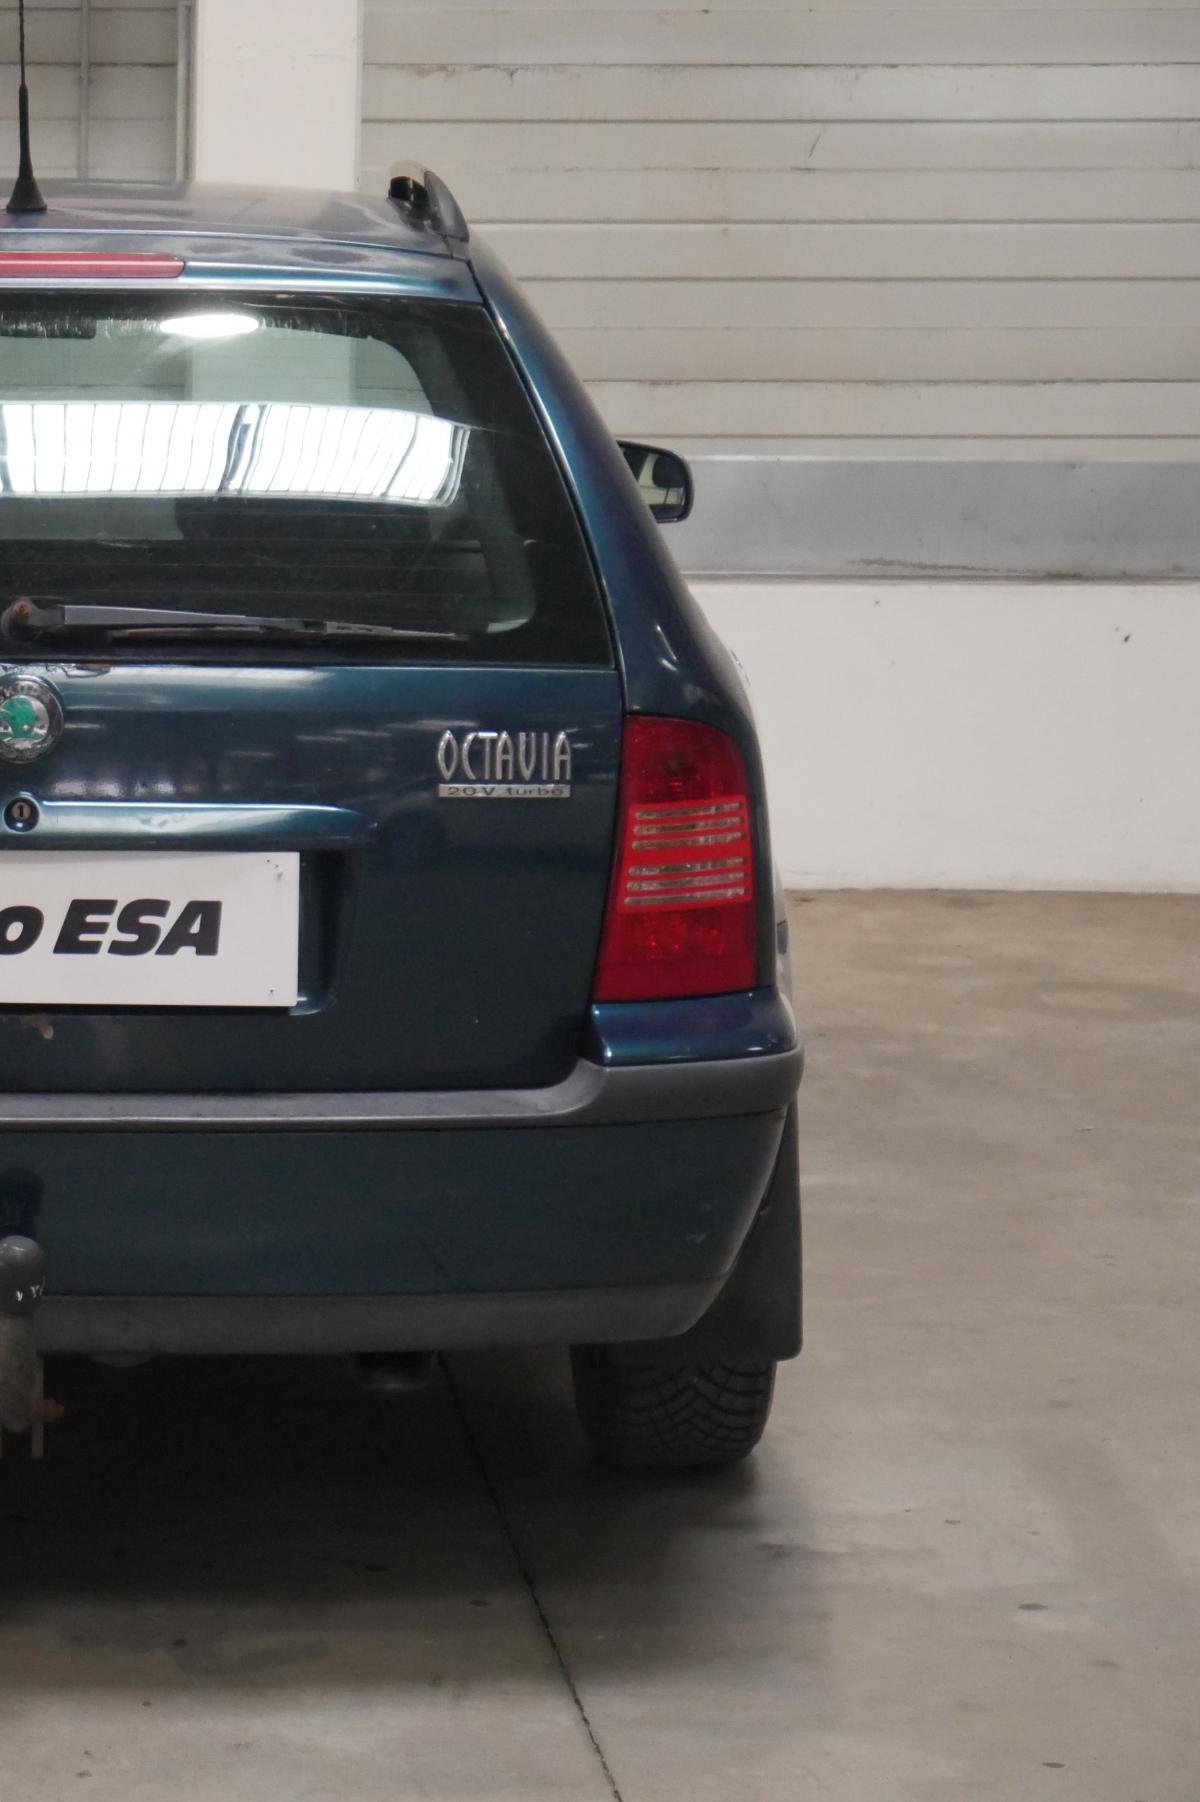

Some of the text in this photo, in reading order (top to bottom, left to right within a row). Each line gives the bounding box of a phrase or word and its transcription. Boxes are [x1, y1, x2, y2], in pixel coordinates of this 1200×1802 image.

[437, 730, 572, 781] OCTAVIA
[504, 785, 564, 797] turbo
[52, 898, 223, 957] ESA
